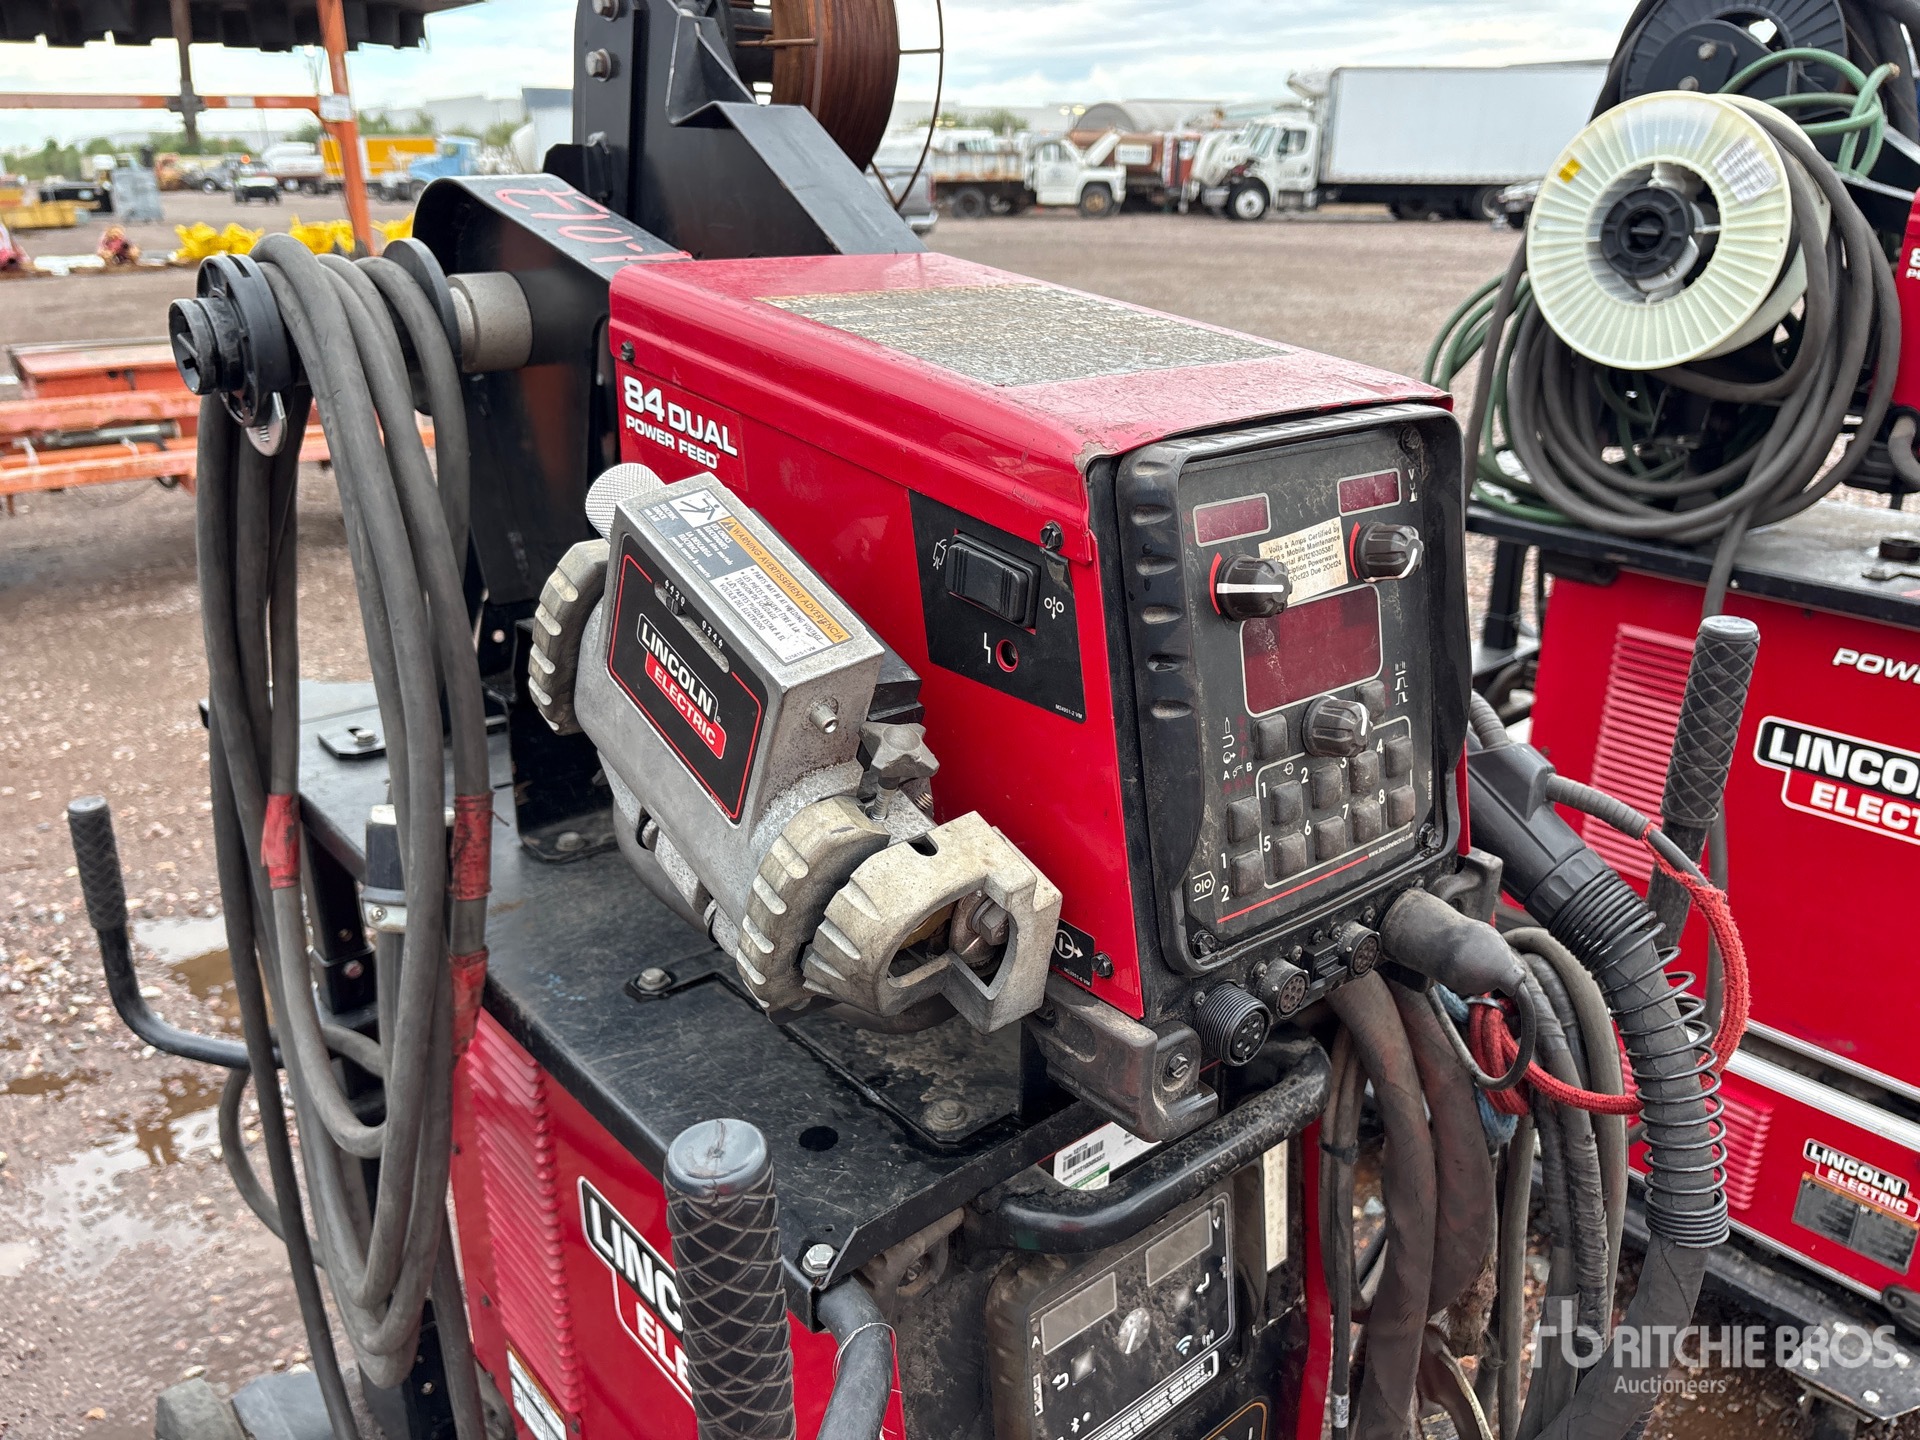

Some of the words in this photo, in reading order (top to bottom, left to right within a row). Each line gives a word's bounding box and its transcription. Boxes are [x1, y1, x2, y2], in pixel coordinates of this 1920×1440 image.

[624, 375, 665, 423] 84
[668, 402, 738, 457] DUAL
[625, 414, 675, 450] POWER
[679, 438, 717, 470] FEED
[1268, 546, 1283, 555] Volts
[1291, 537, 1307, 548] Amps
[1308, 528, 1332, 541] Certified
[1333, 525, 1340, 534] by
[1286, 546, 1306, 557] Mobile
[1306, 534, 1341, 549] Maintenance
[1284, 558, 1296, 568] rial
[1308, 552, 1338, 568] Powerwave
[741, 574, 752, 582] LES
[1310, 567, 1322, 577] Due
[731, 528, 763, 556] WARNING
[758, 555, 806, 599] AVERTISSEMENT
[799, 598, 845, 640] ADVERTENCIA
[717, 583, 737, 600] VOLTAJE
[733, 599, 745, 607] DEL
[740, 607, 766, 630] ELECTRODO
[734, 577, 754, 594] TENSION
[755, 600, 778, 620] SOUDAGE
[752, 571, 768, 584] PARTS
[764, 583, 777, 593] MAY
[783, 603, 805, 623] WELDING
[801, 622, 823, 641] VOLTAGE
[732, 588, 750, 603] PARTES
[746, 602, 765, 619] PUEDEN
[761, 618, 777, 631] ESTAR
[642, 623, 713, 717] LINCOLN
[654, 665, 717, 745] ELECTRIC
[1376, 738, 1384, 754] 4
[1340, 757, 1347, 769] 3
[1769, 726, 1920, 799] LINCO
[1223, 771, 1230, 780] A
[1246, 763, 1252, 772] B
[1301, 767, 1309, 784] 2
[1261, 782, 1266, 798] 1
[1378, 789, 1385, 804] 8
[1343, 804, 1349, 820] 7
[1304, 820, 1311, 836] 6
[1264, 835, 1271, 851] 5
[1221, 853, 1226, 868] 1
[1221, 885, 1229, 902] 2
[1810, 1143, 1902, 1196] LINCOLN
[1828, 1168, 1909, 1214] ELECTRIC
[1212, 1216, 1220, 1230] V
[590, 1197, 684, 1332] LINC
[1031, 1335, 1041, 1349] A
